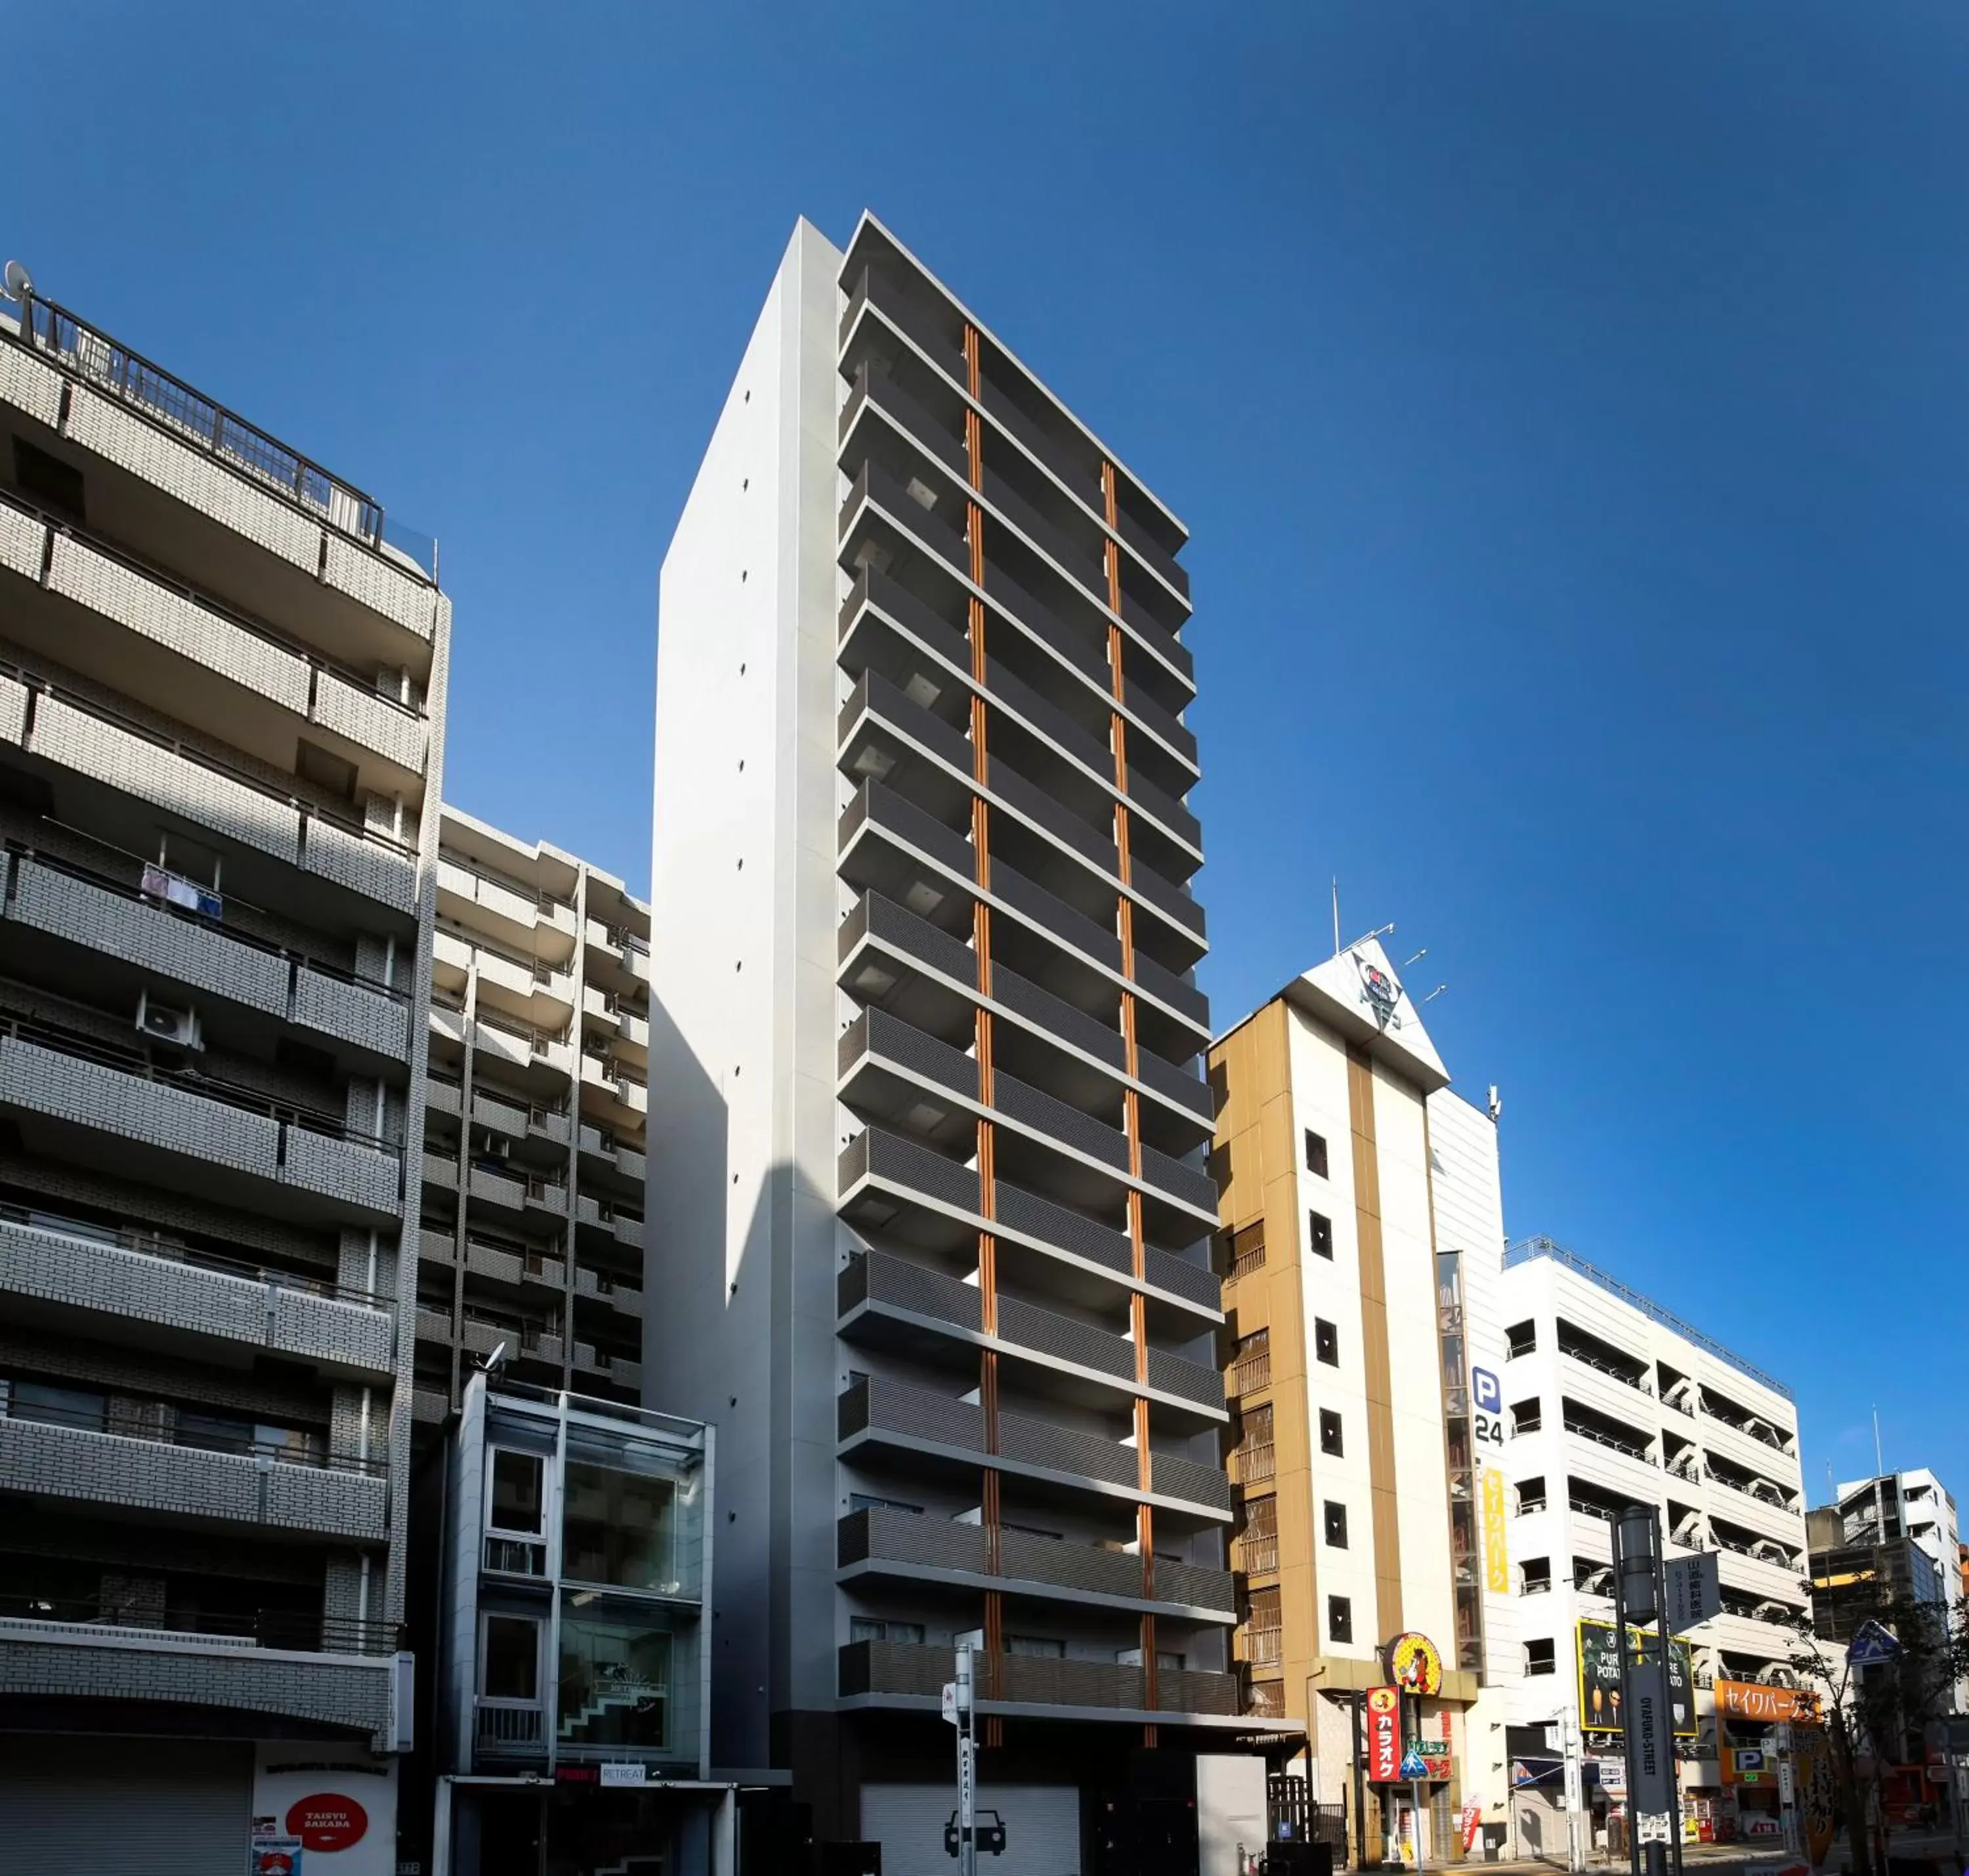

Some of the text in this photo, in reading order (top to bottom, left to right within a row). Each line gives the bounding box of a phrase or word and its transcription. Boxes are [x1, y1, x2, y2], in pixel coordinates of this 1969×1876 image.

[1476, 1372, 1496, 1403] P
[1475, 1413, 1504, 1447] 24
[1488, 1473, 1506, 1588] セイワパーク
[1601, 1652, 1619, 1666] PUR
[1378, 1715, 1394, 1778] カラオケ
[1739, 1752, 1761, 1770] P
[603, 1768, 643, 1780] RETREAT
[304, 1820, 350, 1828] SAKABA
